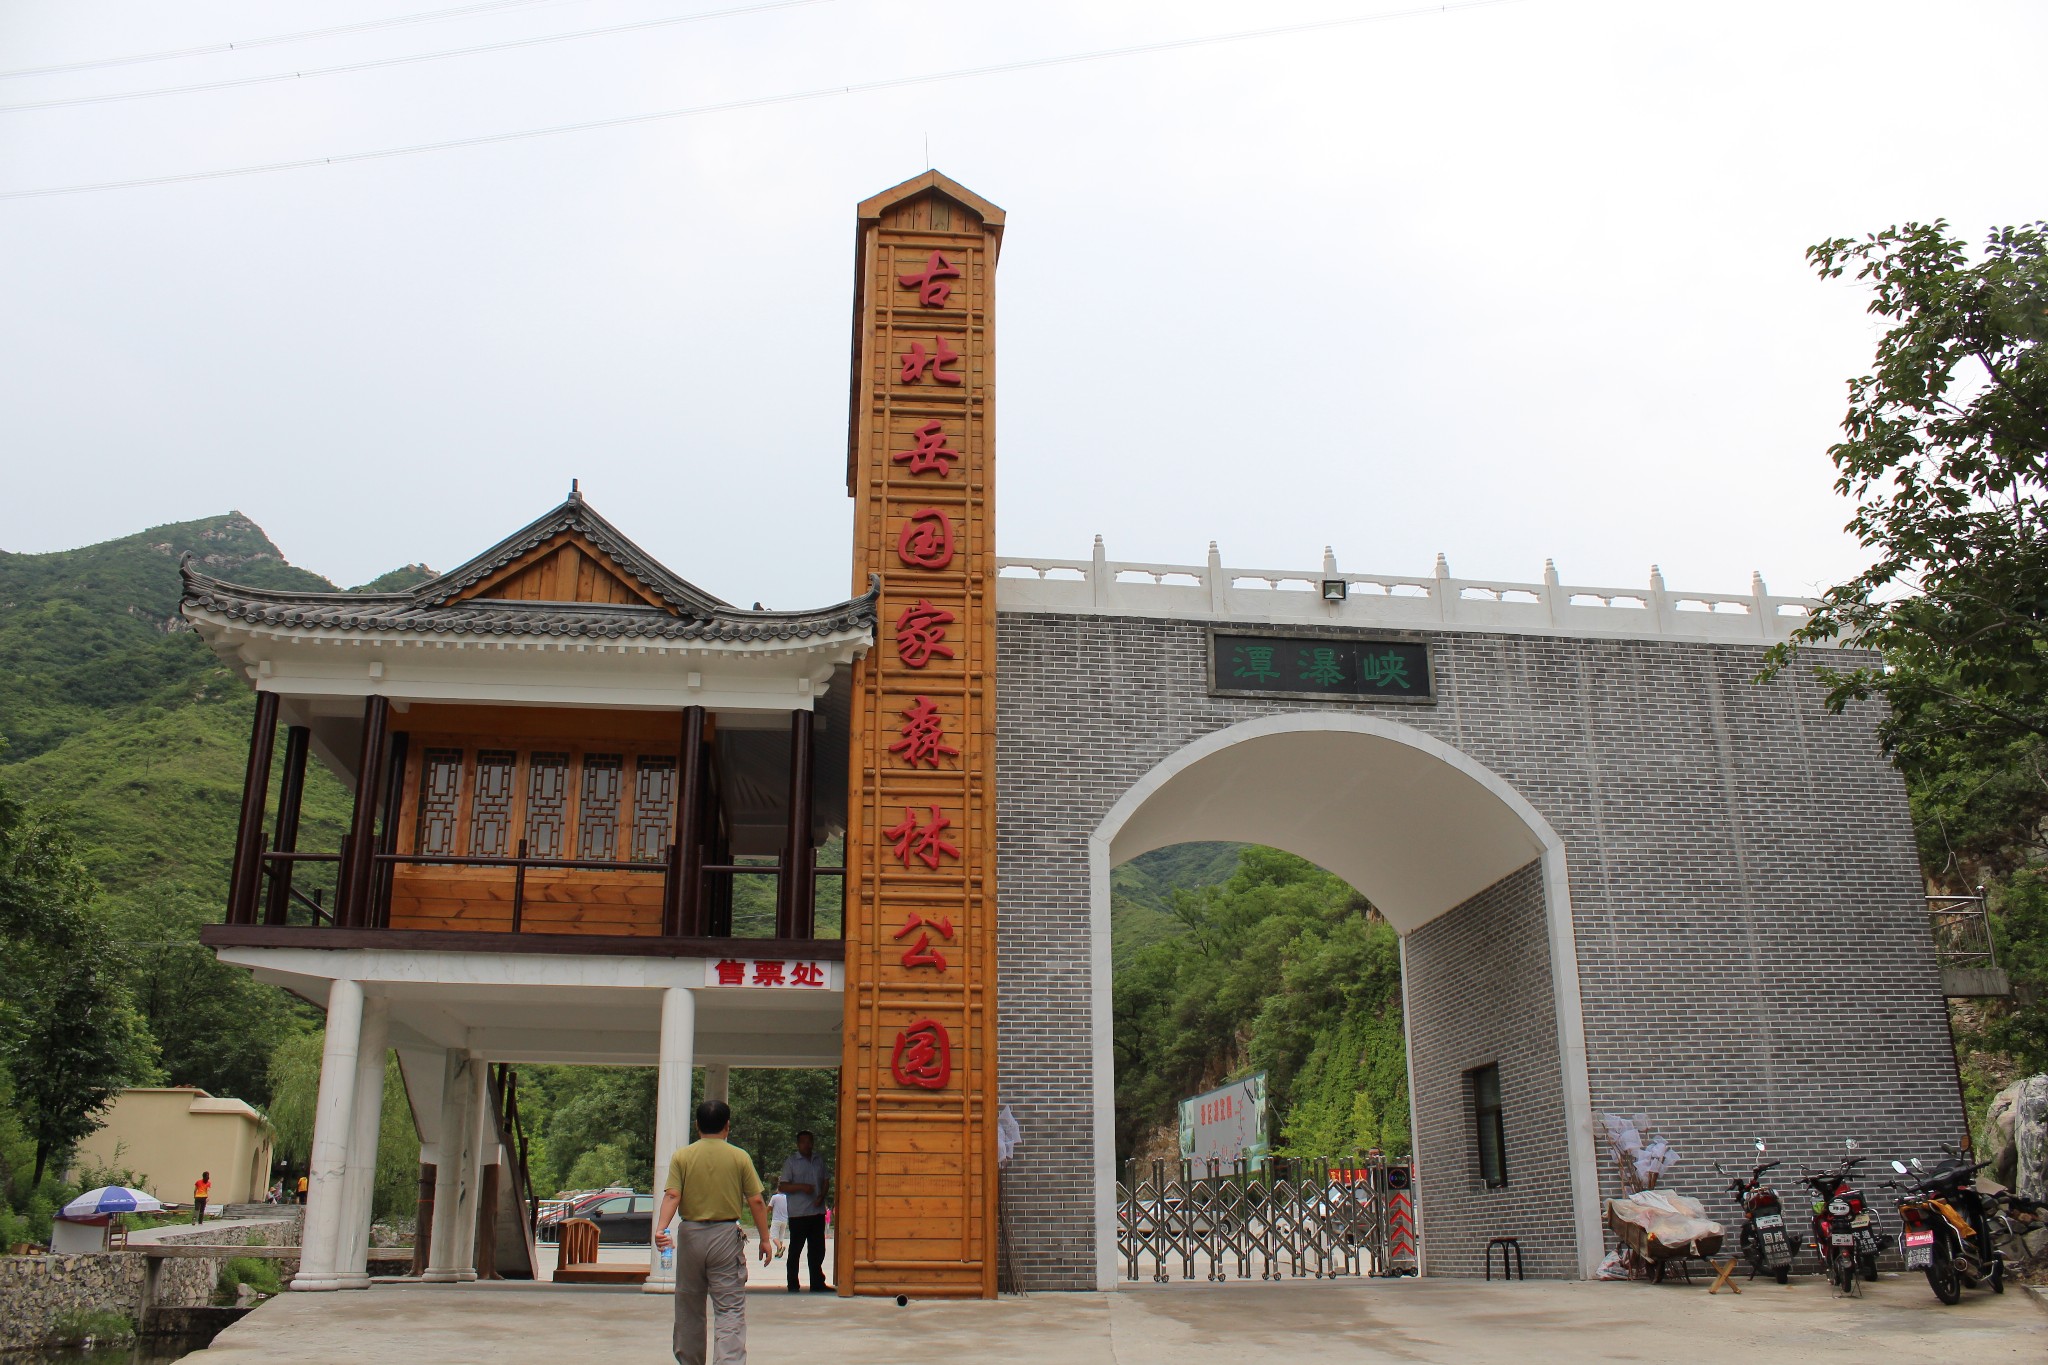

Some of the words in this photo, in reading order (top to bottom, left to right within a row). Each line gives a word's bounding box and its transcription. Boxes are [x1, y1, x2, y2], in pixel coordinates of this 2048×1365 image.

[883, 249, 961, 1090] 古北岳国家森林公园
[1232, 646, 1411, 689] 潭瀑峡
[714, 959, 824, 987] 售票处
